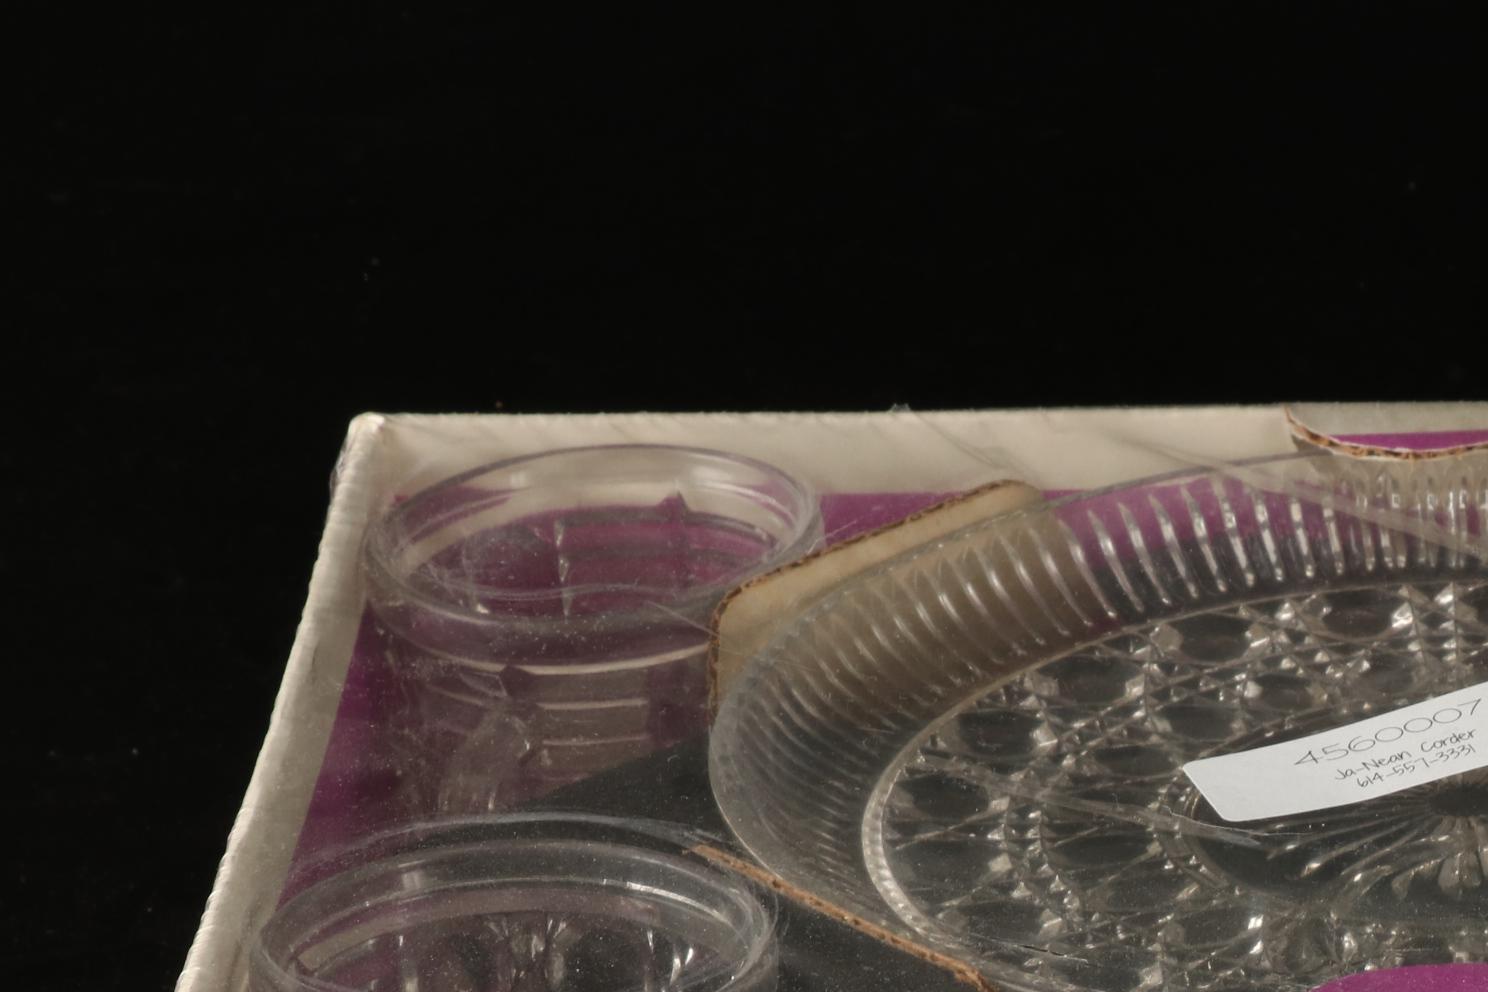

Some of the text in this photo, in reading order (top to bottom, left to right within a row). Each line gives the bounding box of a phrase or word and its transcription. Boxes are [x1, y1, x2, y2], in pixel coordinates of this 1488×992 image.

[1294, 697, 1482, 766] 4560007
[1420, 728, 1477, 753] Corder
[1355, 744, 1477, 789] 614-557-3331
